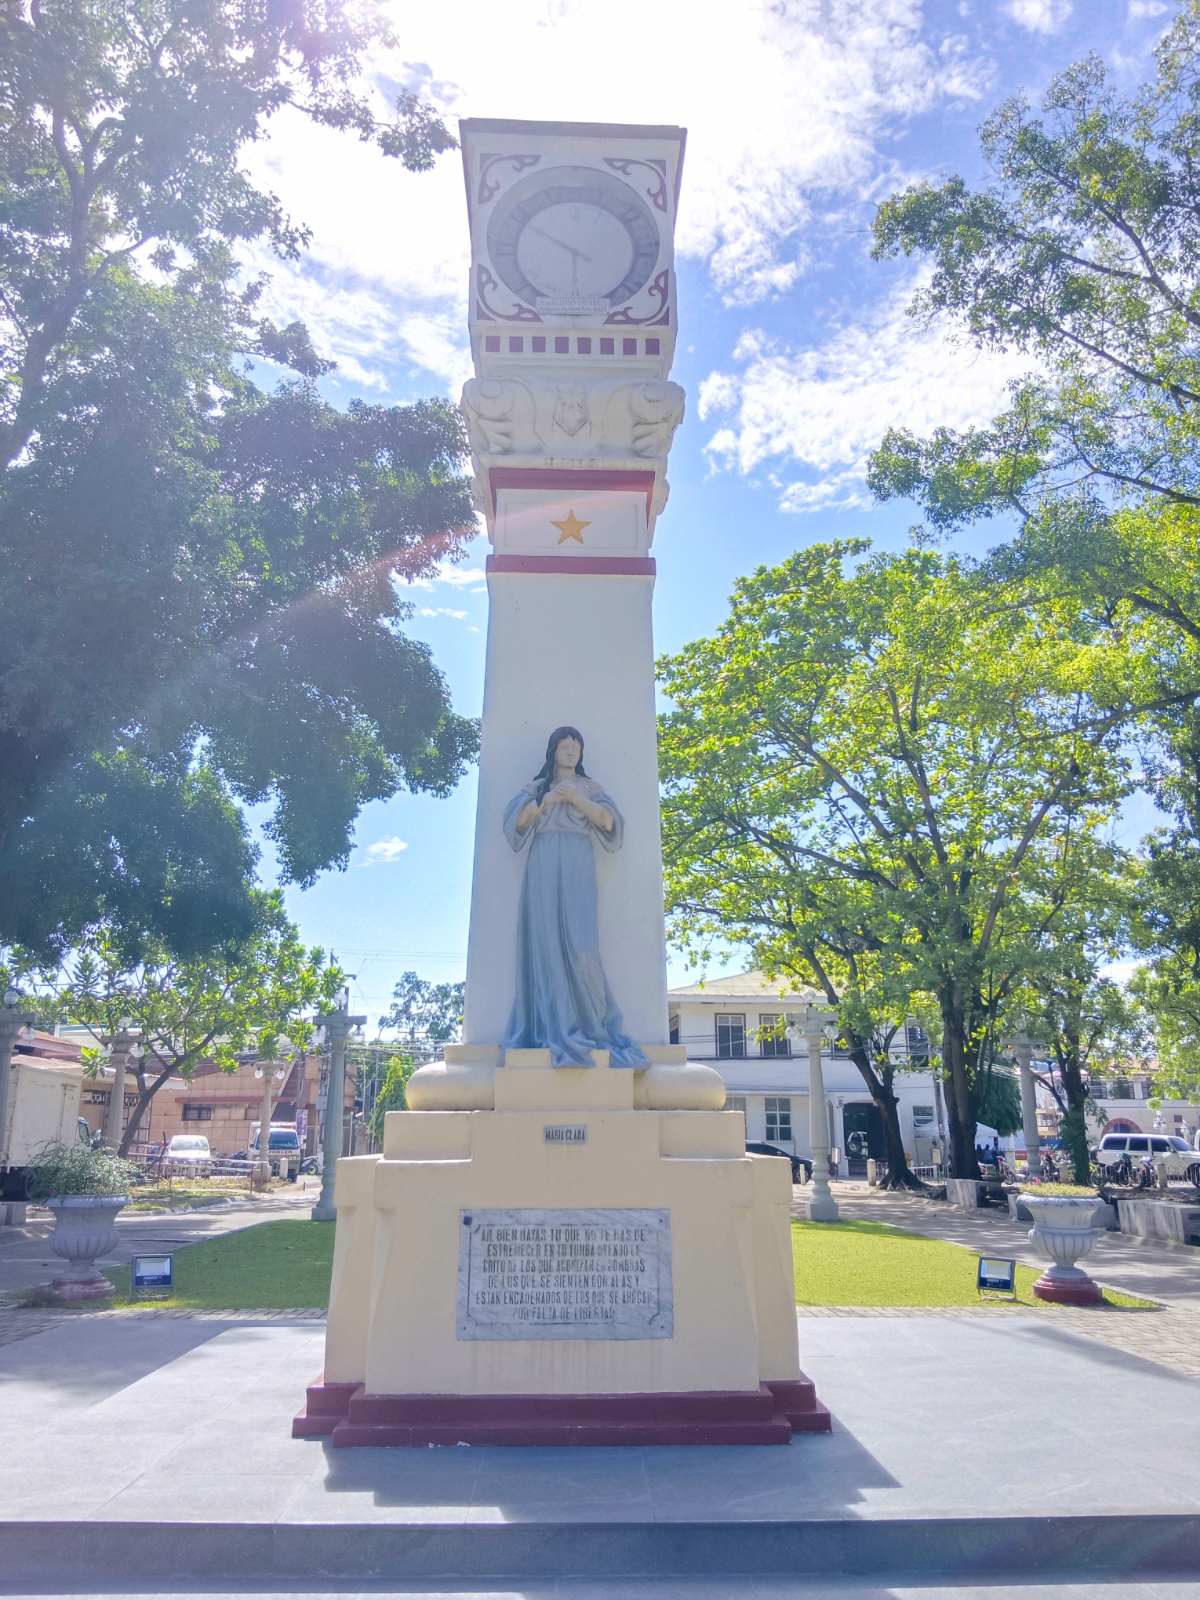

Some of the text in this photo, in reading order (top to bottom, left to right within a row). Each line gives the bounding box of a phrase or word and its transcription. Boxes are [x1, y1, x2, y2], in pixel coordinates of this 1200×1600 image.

[496, 1228, 517, 1242] BIEN
[520, 1228, 546, 1242] HAYAS
[565, 1228, 580, 1242] QUE
[634, 1228, 646, 1242] DE
[544, 1244, 554, 1257] EN
[569, 1244, 595, 1257] TUMBA
[483, 1259, 506, 1273] GRITO
[520, 1259, 536, 1273] LOS
[538, 1259, 553, 1274] QUE
[488, 1275, 640, 1289] DE LOS QUE SE SIENTEN CON ALAS Y
[563, 1291, 573, 1304] DE
[575, 1291, 590, 1304] LOS
[592, 1291, 605, 1304] QUE
[609, 1291, 618, 1304] SE
[513, 1307, 529, 1320] POR
[532, 1307, 556, 1320] FALTA
[560, 1307, 570, 1320] DE
